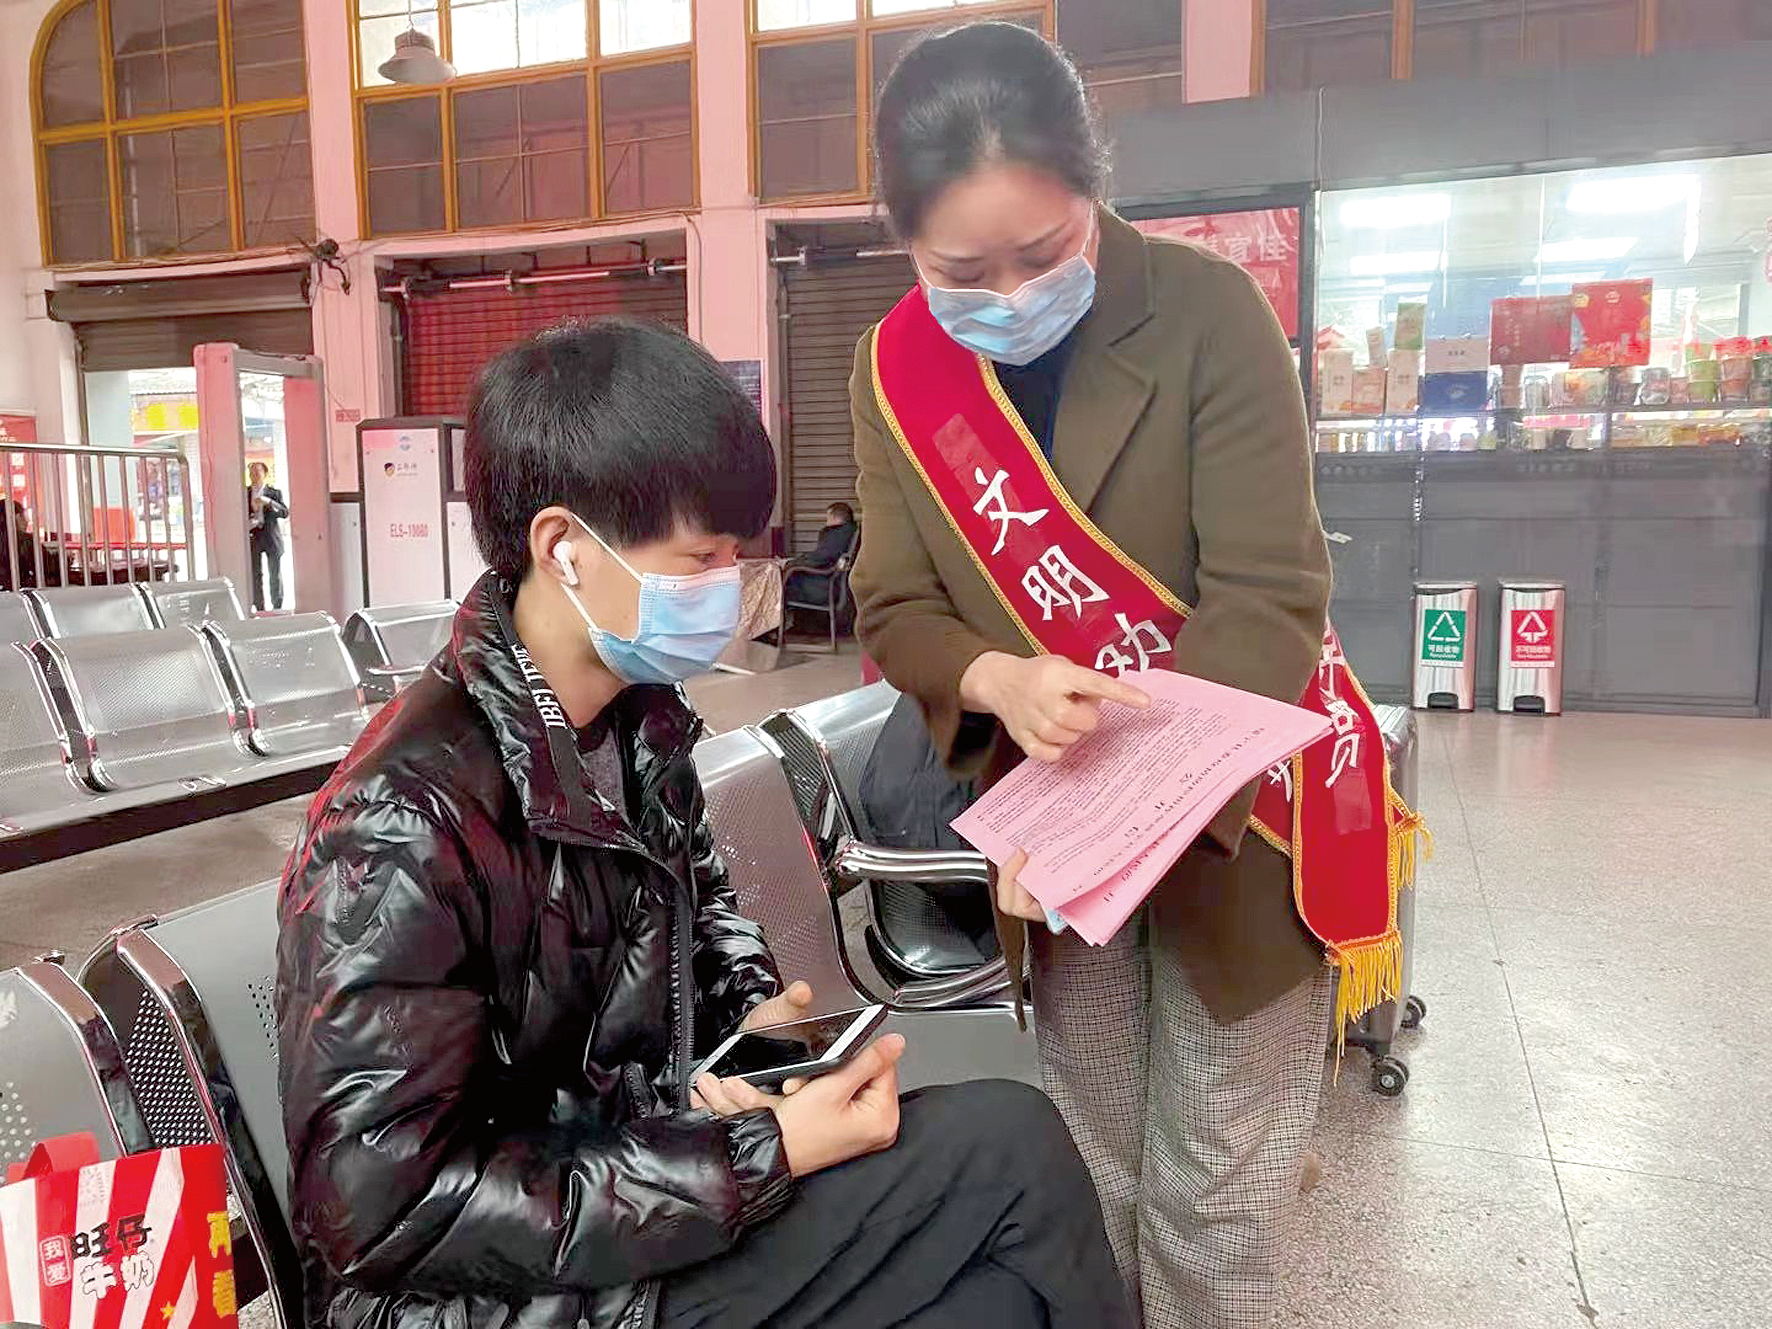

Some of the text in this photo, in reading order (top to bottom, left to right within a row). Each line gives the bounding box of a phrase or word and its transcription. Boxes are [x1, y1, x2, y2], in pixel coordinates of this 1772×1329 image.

[69, 1213, 152, 1260] 旺仔
[44, 1239, 68, 1283] 我爱
[80, 1250, 155, 1300] 牛奶
